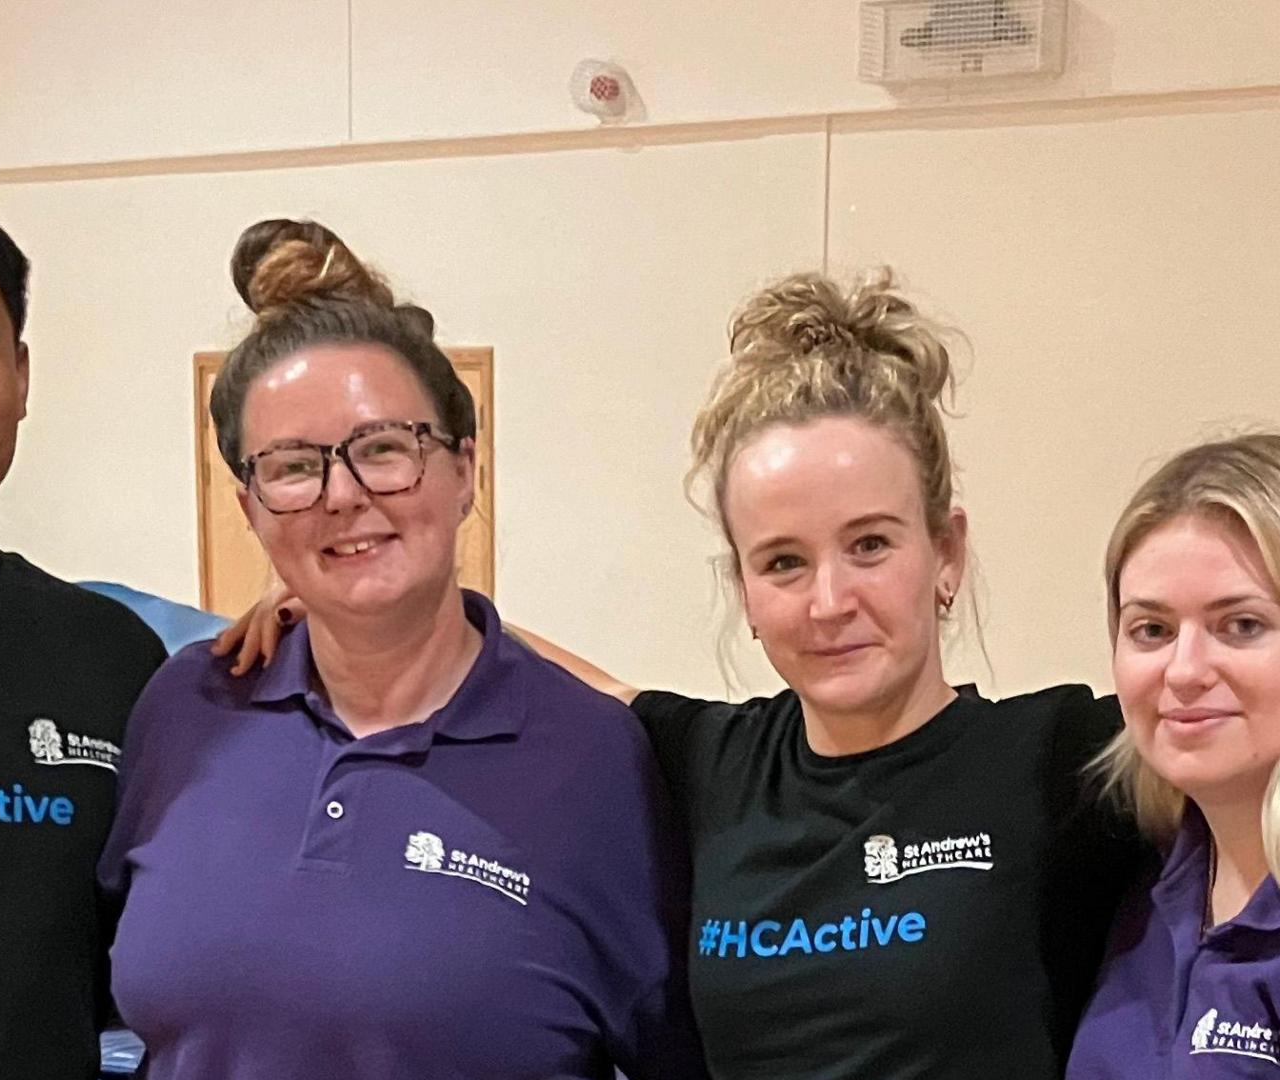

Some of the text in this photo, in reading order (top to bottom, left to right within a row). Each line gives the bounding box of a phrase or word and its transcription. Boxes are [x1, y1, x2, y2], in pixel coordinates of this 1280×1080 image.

[902, 847, 992, 869] HEALTHCARE
[904, 831, 991, 859] St Andrew's
[448, 862, 529, 897] HEALTHCARE
[451, 849, 530, 886] St Andrew's
[699, 908, 926, 958] #HCActive
